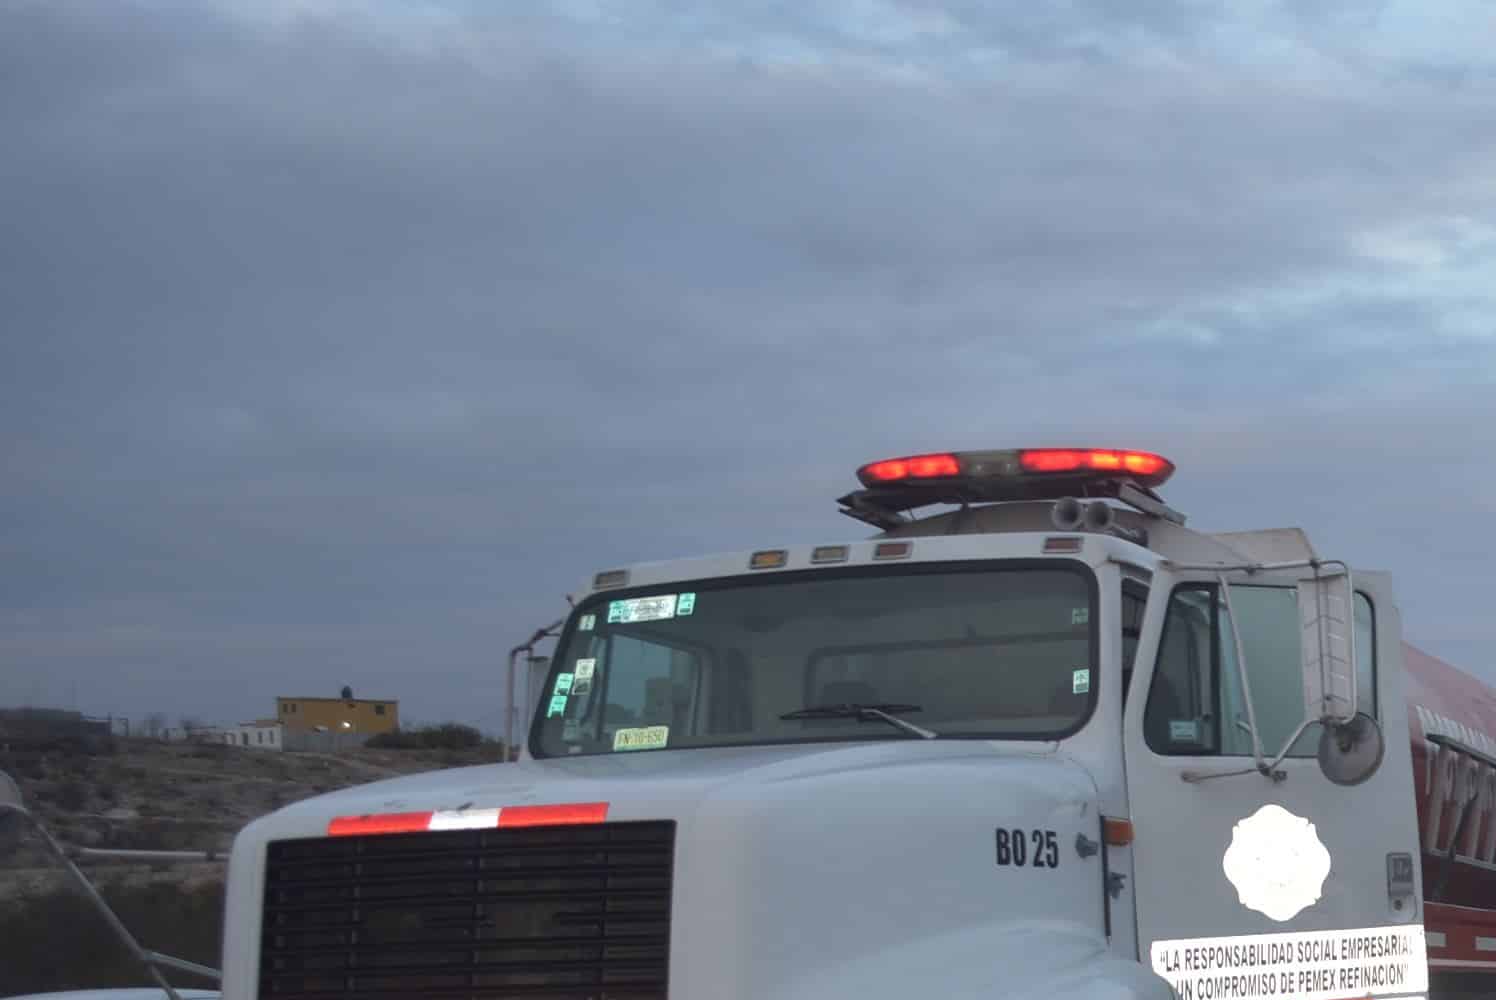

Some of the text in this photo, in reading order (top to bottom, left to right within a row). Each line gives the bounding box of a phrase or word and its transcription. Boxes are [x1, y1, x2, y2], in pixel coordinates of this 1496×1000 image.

[1031, 829, 1059, 868] 25
[1185, 942, 1293, 970] RESPONSABILIDAD
[1298, 939, 1337, 963] SOCIAL
[1341, 934, 1413, 960] EMPRESARIAL
[1197, 972, 1276, 1000] COMPROMISO
[1280, 972, 1295, 993] DE
[1299, 969, 1336, 992] PEMEX
